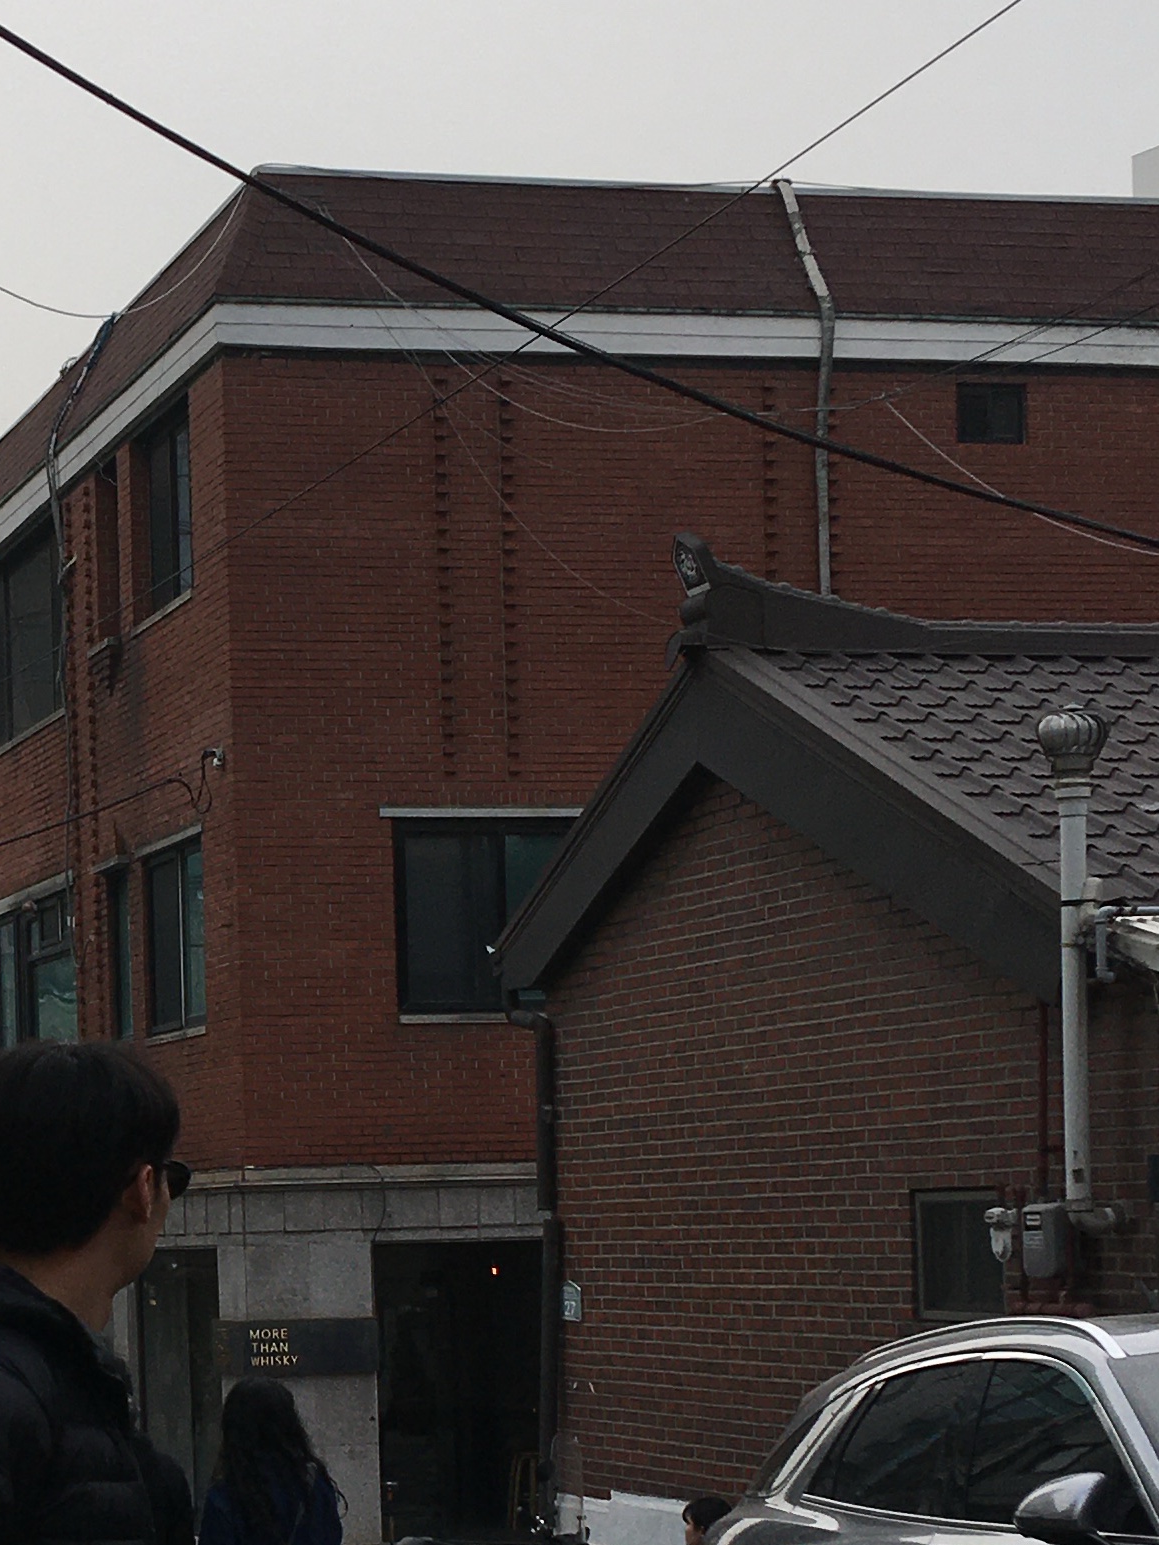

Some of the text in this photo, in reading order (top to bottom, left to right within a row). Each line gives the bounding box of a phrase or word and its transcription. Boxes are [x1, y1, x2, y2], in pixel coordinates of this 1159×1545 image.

[564, 1300, 576, 1316] 27
[249, 1328, 288, 1339] MORE
[251, 1342, 289, 1353] THAN
[251, 1355, 298, 1367] WHISKY
